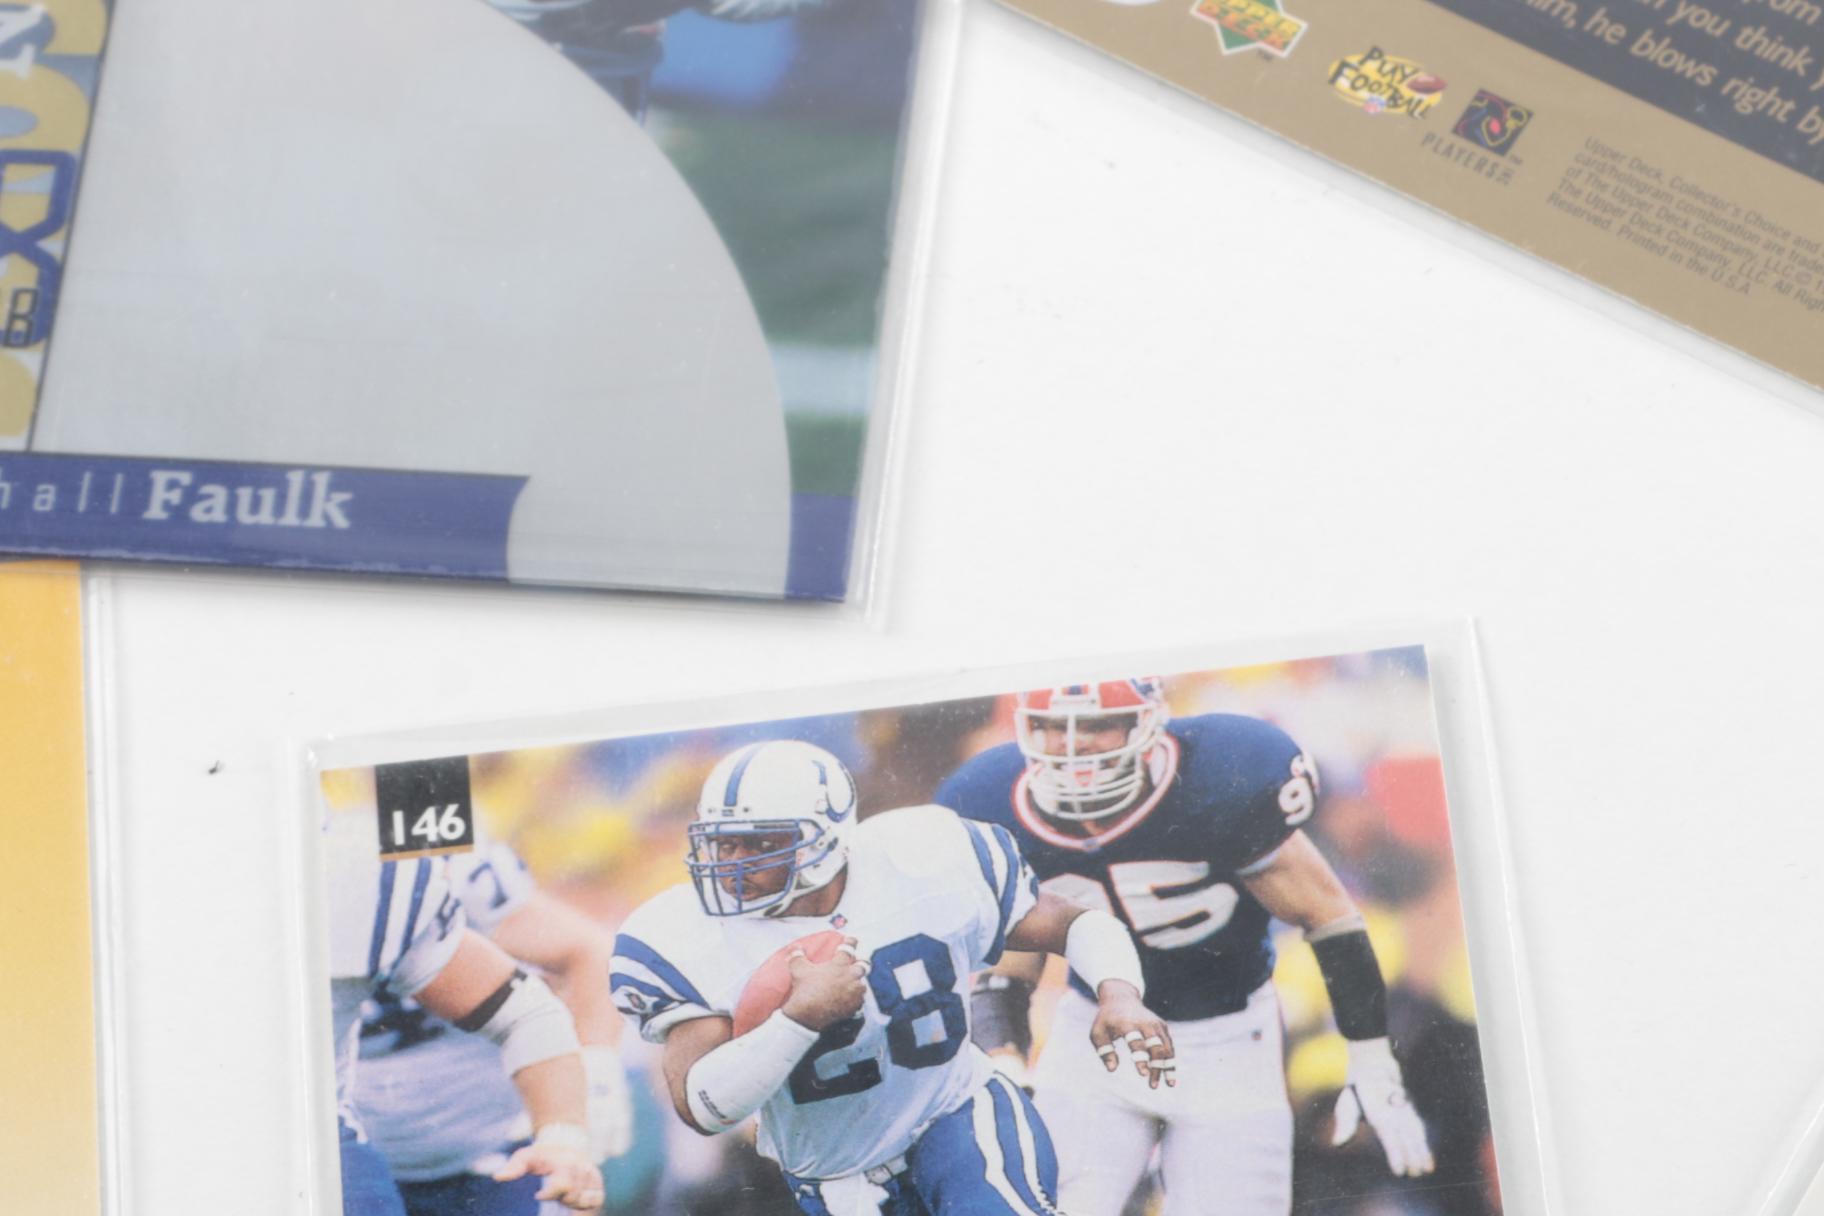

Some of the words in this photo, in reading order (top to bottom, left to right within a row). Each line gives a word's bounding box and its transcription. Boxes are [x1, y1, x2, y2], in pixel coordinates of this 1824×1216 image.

[1583, 6, 1628, 45] he
[1629, 28, 1718, 86] blows
[1720, 77, 1796, 123] right
[1666, 0, 1732, 38] you
[1734, 25, 1813, 77] think
[1420, 132, 1498, 176] PLAYERS
[142, 470, 354, 529] Faulk
[391, 804, 466, 846] 146
